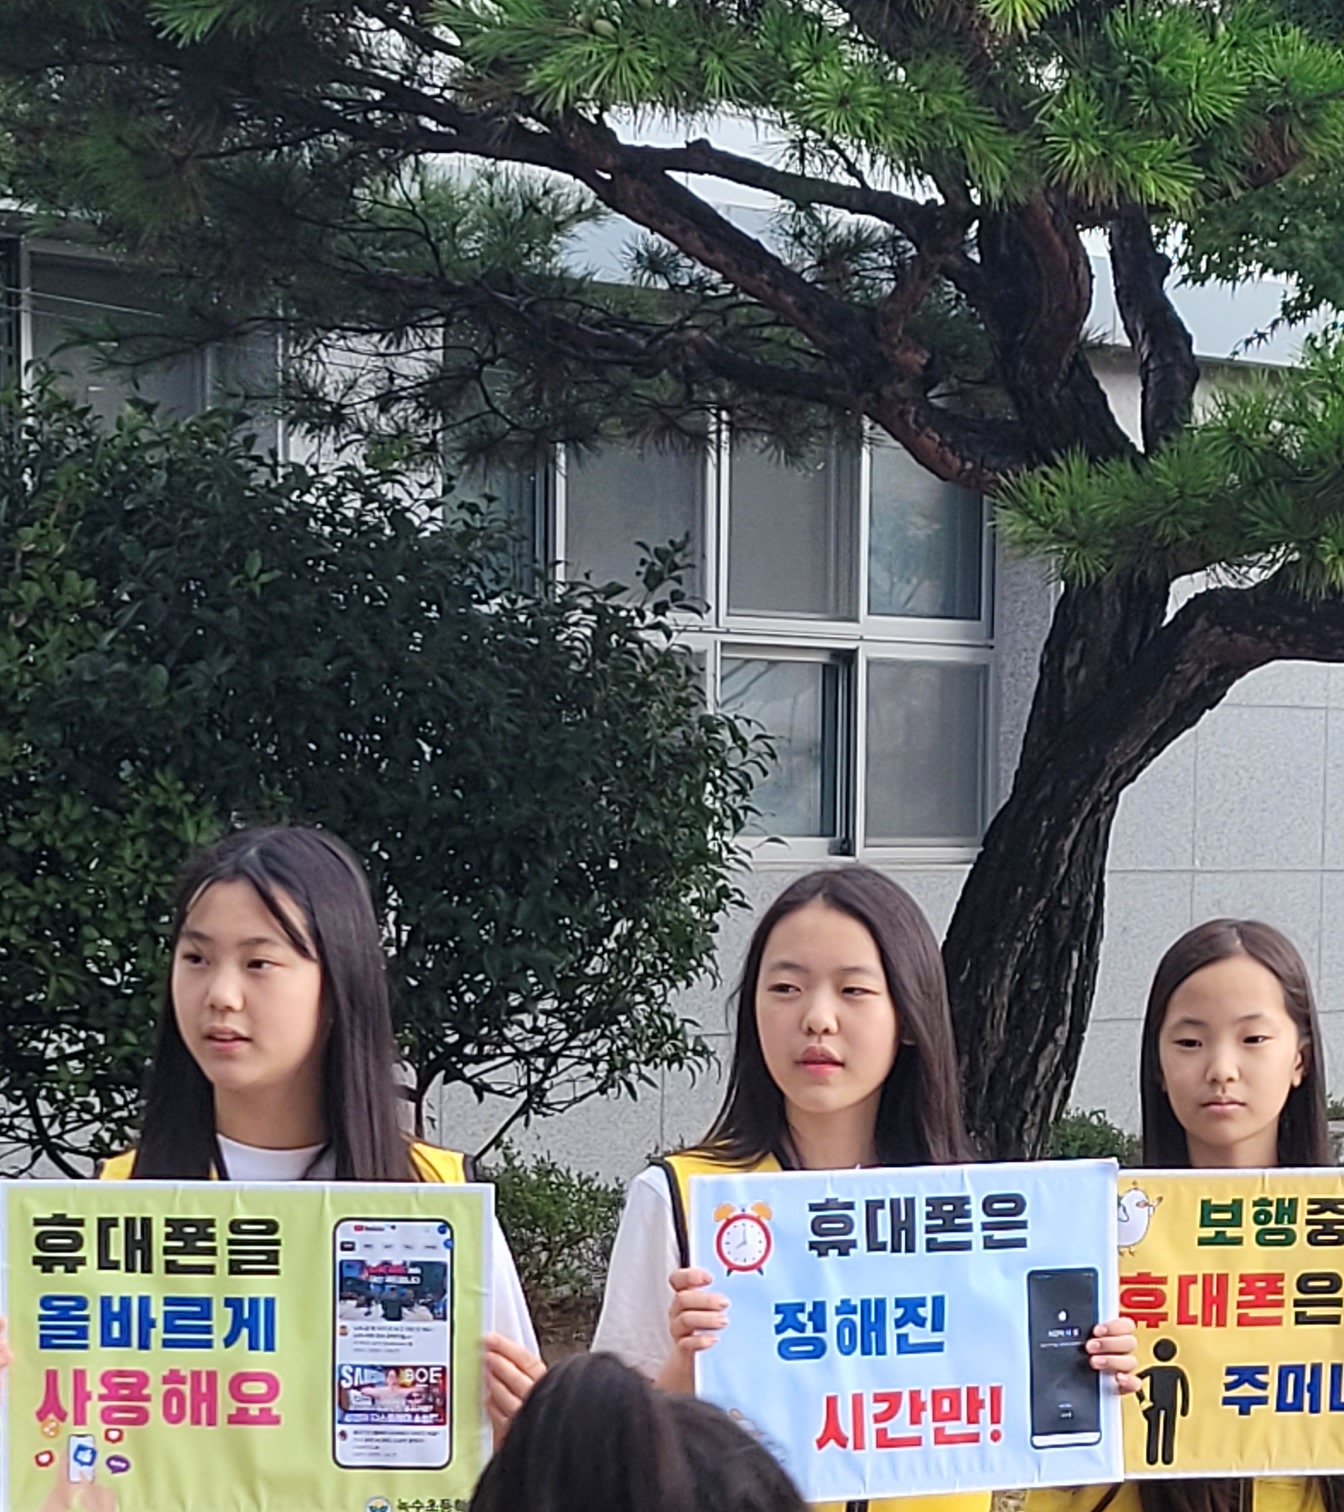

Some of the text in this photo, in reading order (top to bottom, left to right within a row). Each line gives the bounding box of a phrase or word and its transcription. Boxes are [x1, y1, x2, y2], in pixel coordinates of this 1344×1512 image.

[32, 1213, 282, 1276] 휴대폰을
[807, 1192, 1029, 1257] 휴대폰은
[37, 1294, 277, 1352] 올바르게
[773, 1294, 946, 1360] 정해진
[1119, 1271, 1344, 1328] 휴대폰은
[35, 1368, 282, 1427] 사용해요
[816, 1385, 1004, 1452] 시간만!
